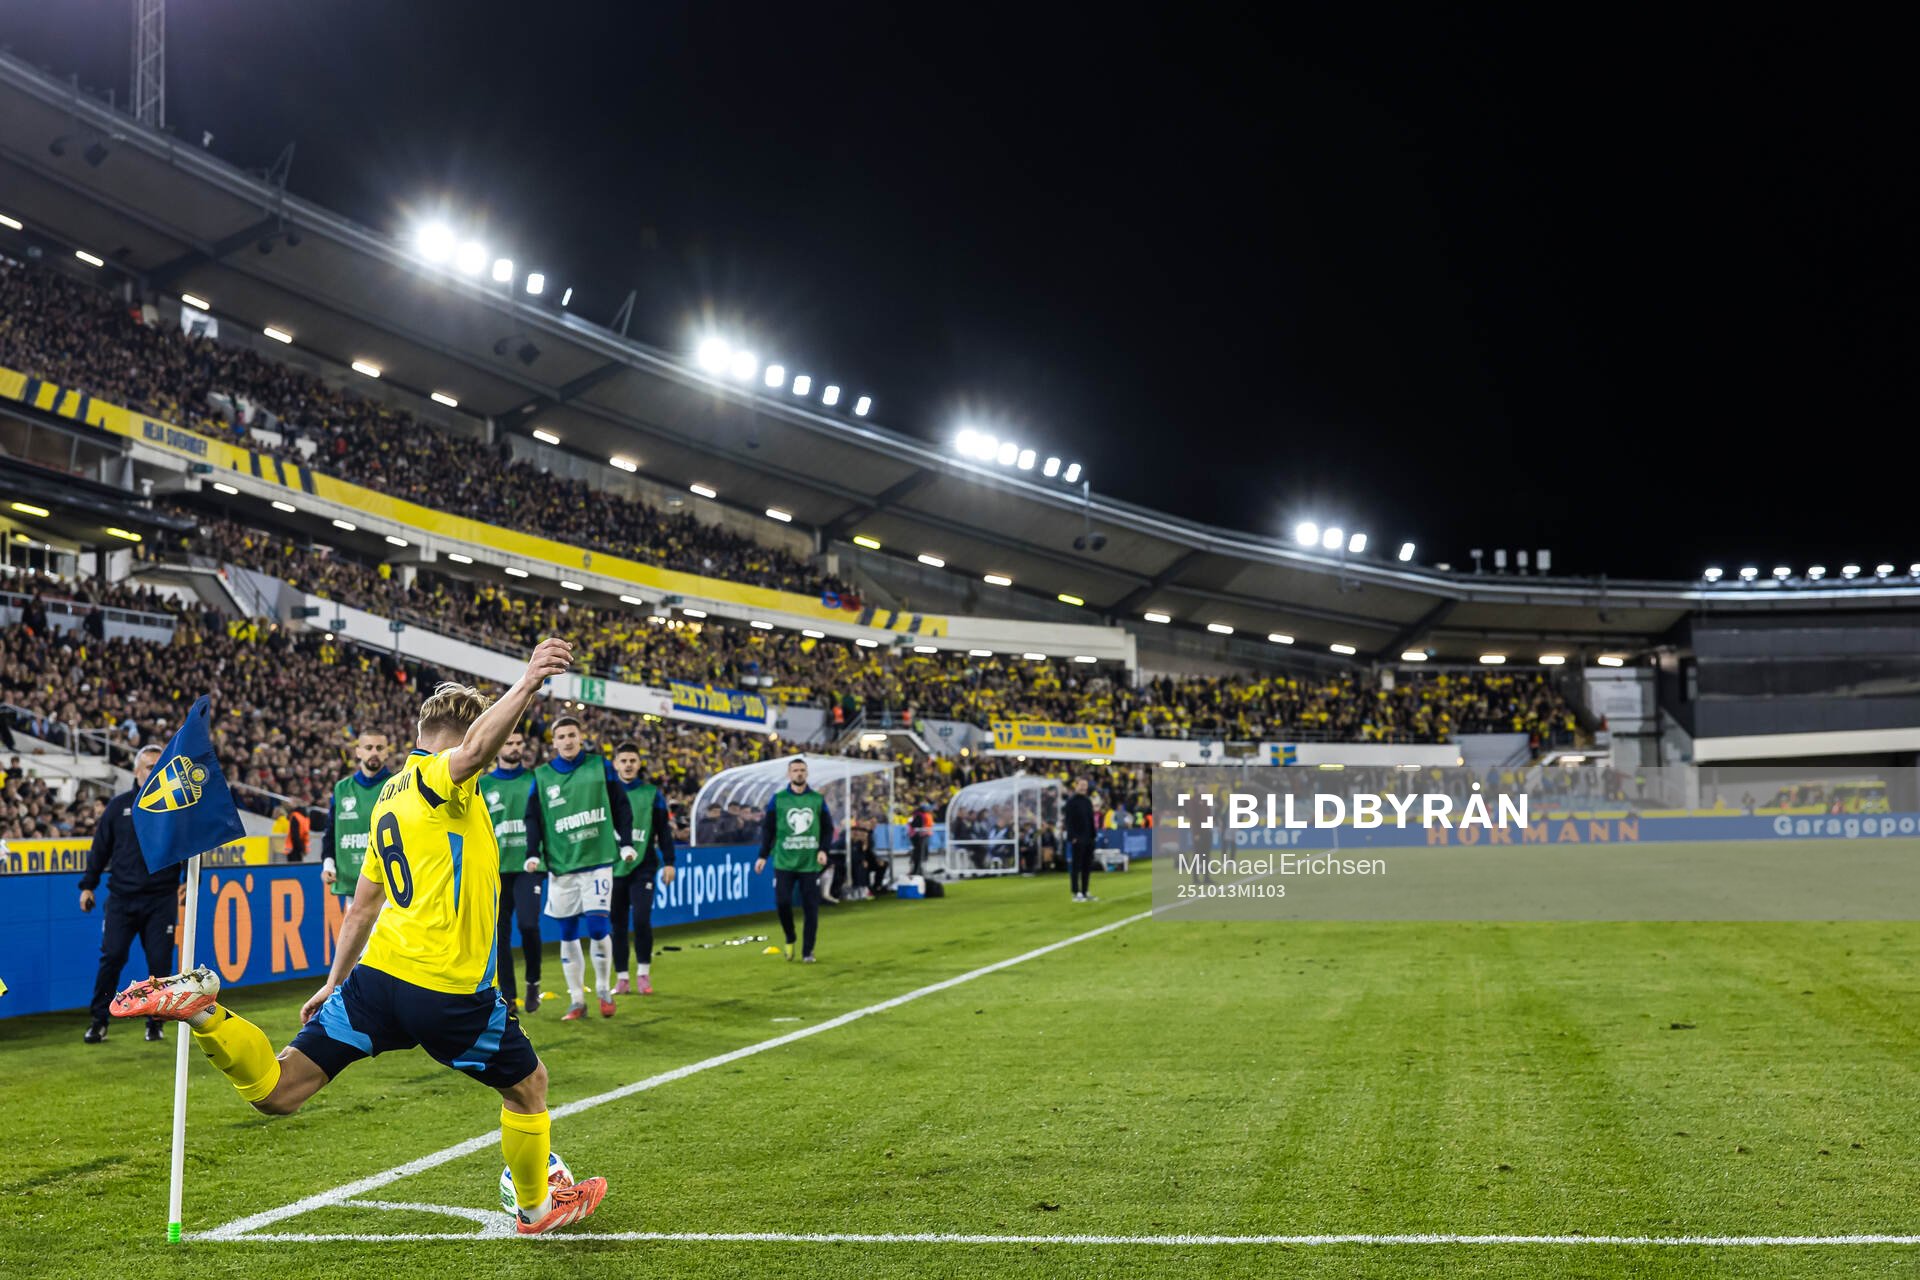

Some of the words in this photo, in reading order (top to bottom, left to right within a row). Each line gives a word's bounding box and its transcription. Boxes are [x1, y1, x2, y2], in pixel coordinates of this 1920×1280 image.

[555, 807, 607, 833] #FOOTBALL
[1773, 814, 1920, 838] Garagepo
[376, 811, 414, 908] 8
[594, 879, 610, 896] 19
